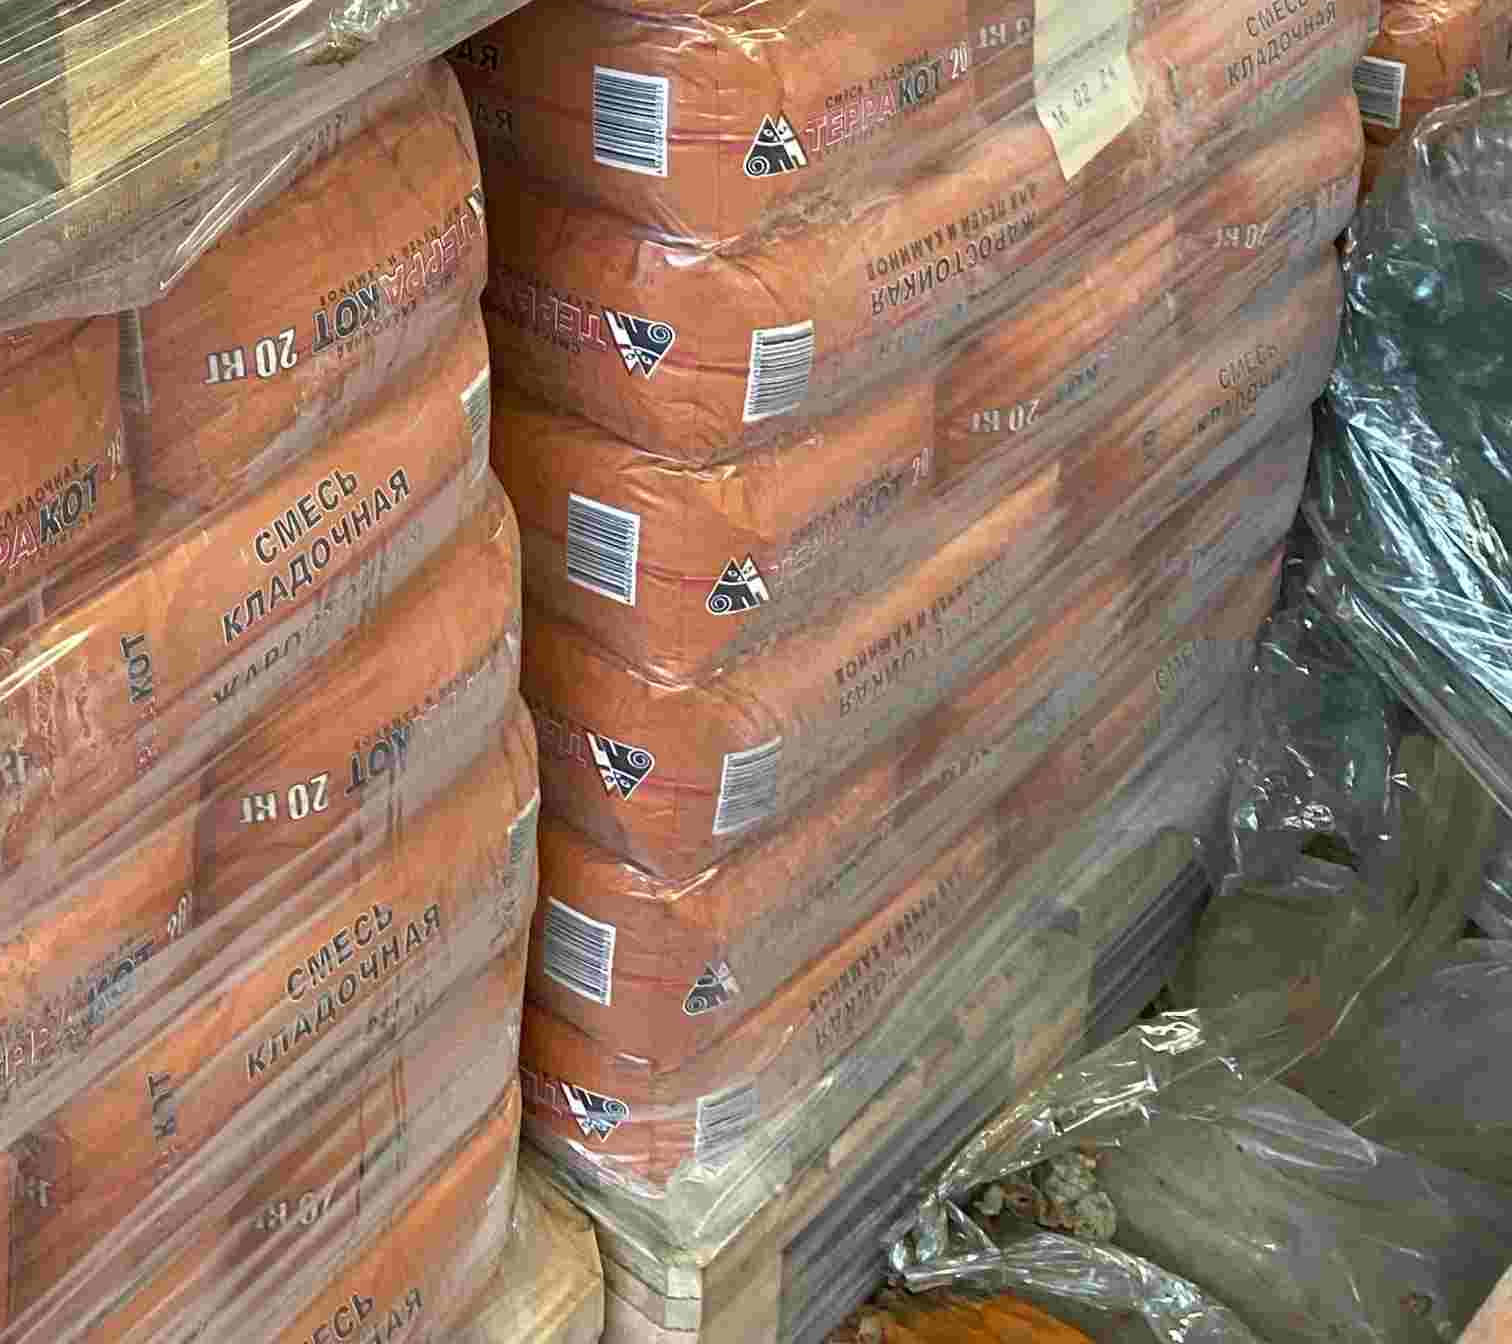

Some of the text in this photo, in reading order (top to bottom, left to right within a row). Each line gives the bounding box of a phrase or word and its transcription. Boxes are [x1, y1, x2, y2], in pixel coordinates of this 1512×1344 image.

[256, 330, 299, 377] 20
[221, 468, 412, 646] КЛАДОЧНАЯ
[252, 467, 360, 568] СМЕСЬ
[289, 775, 329, 821] 20
[246, 904, 442, 1082] КЛАДОЧНАЯ
[284, 902, 395, 1003] СМЕСЬ
